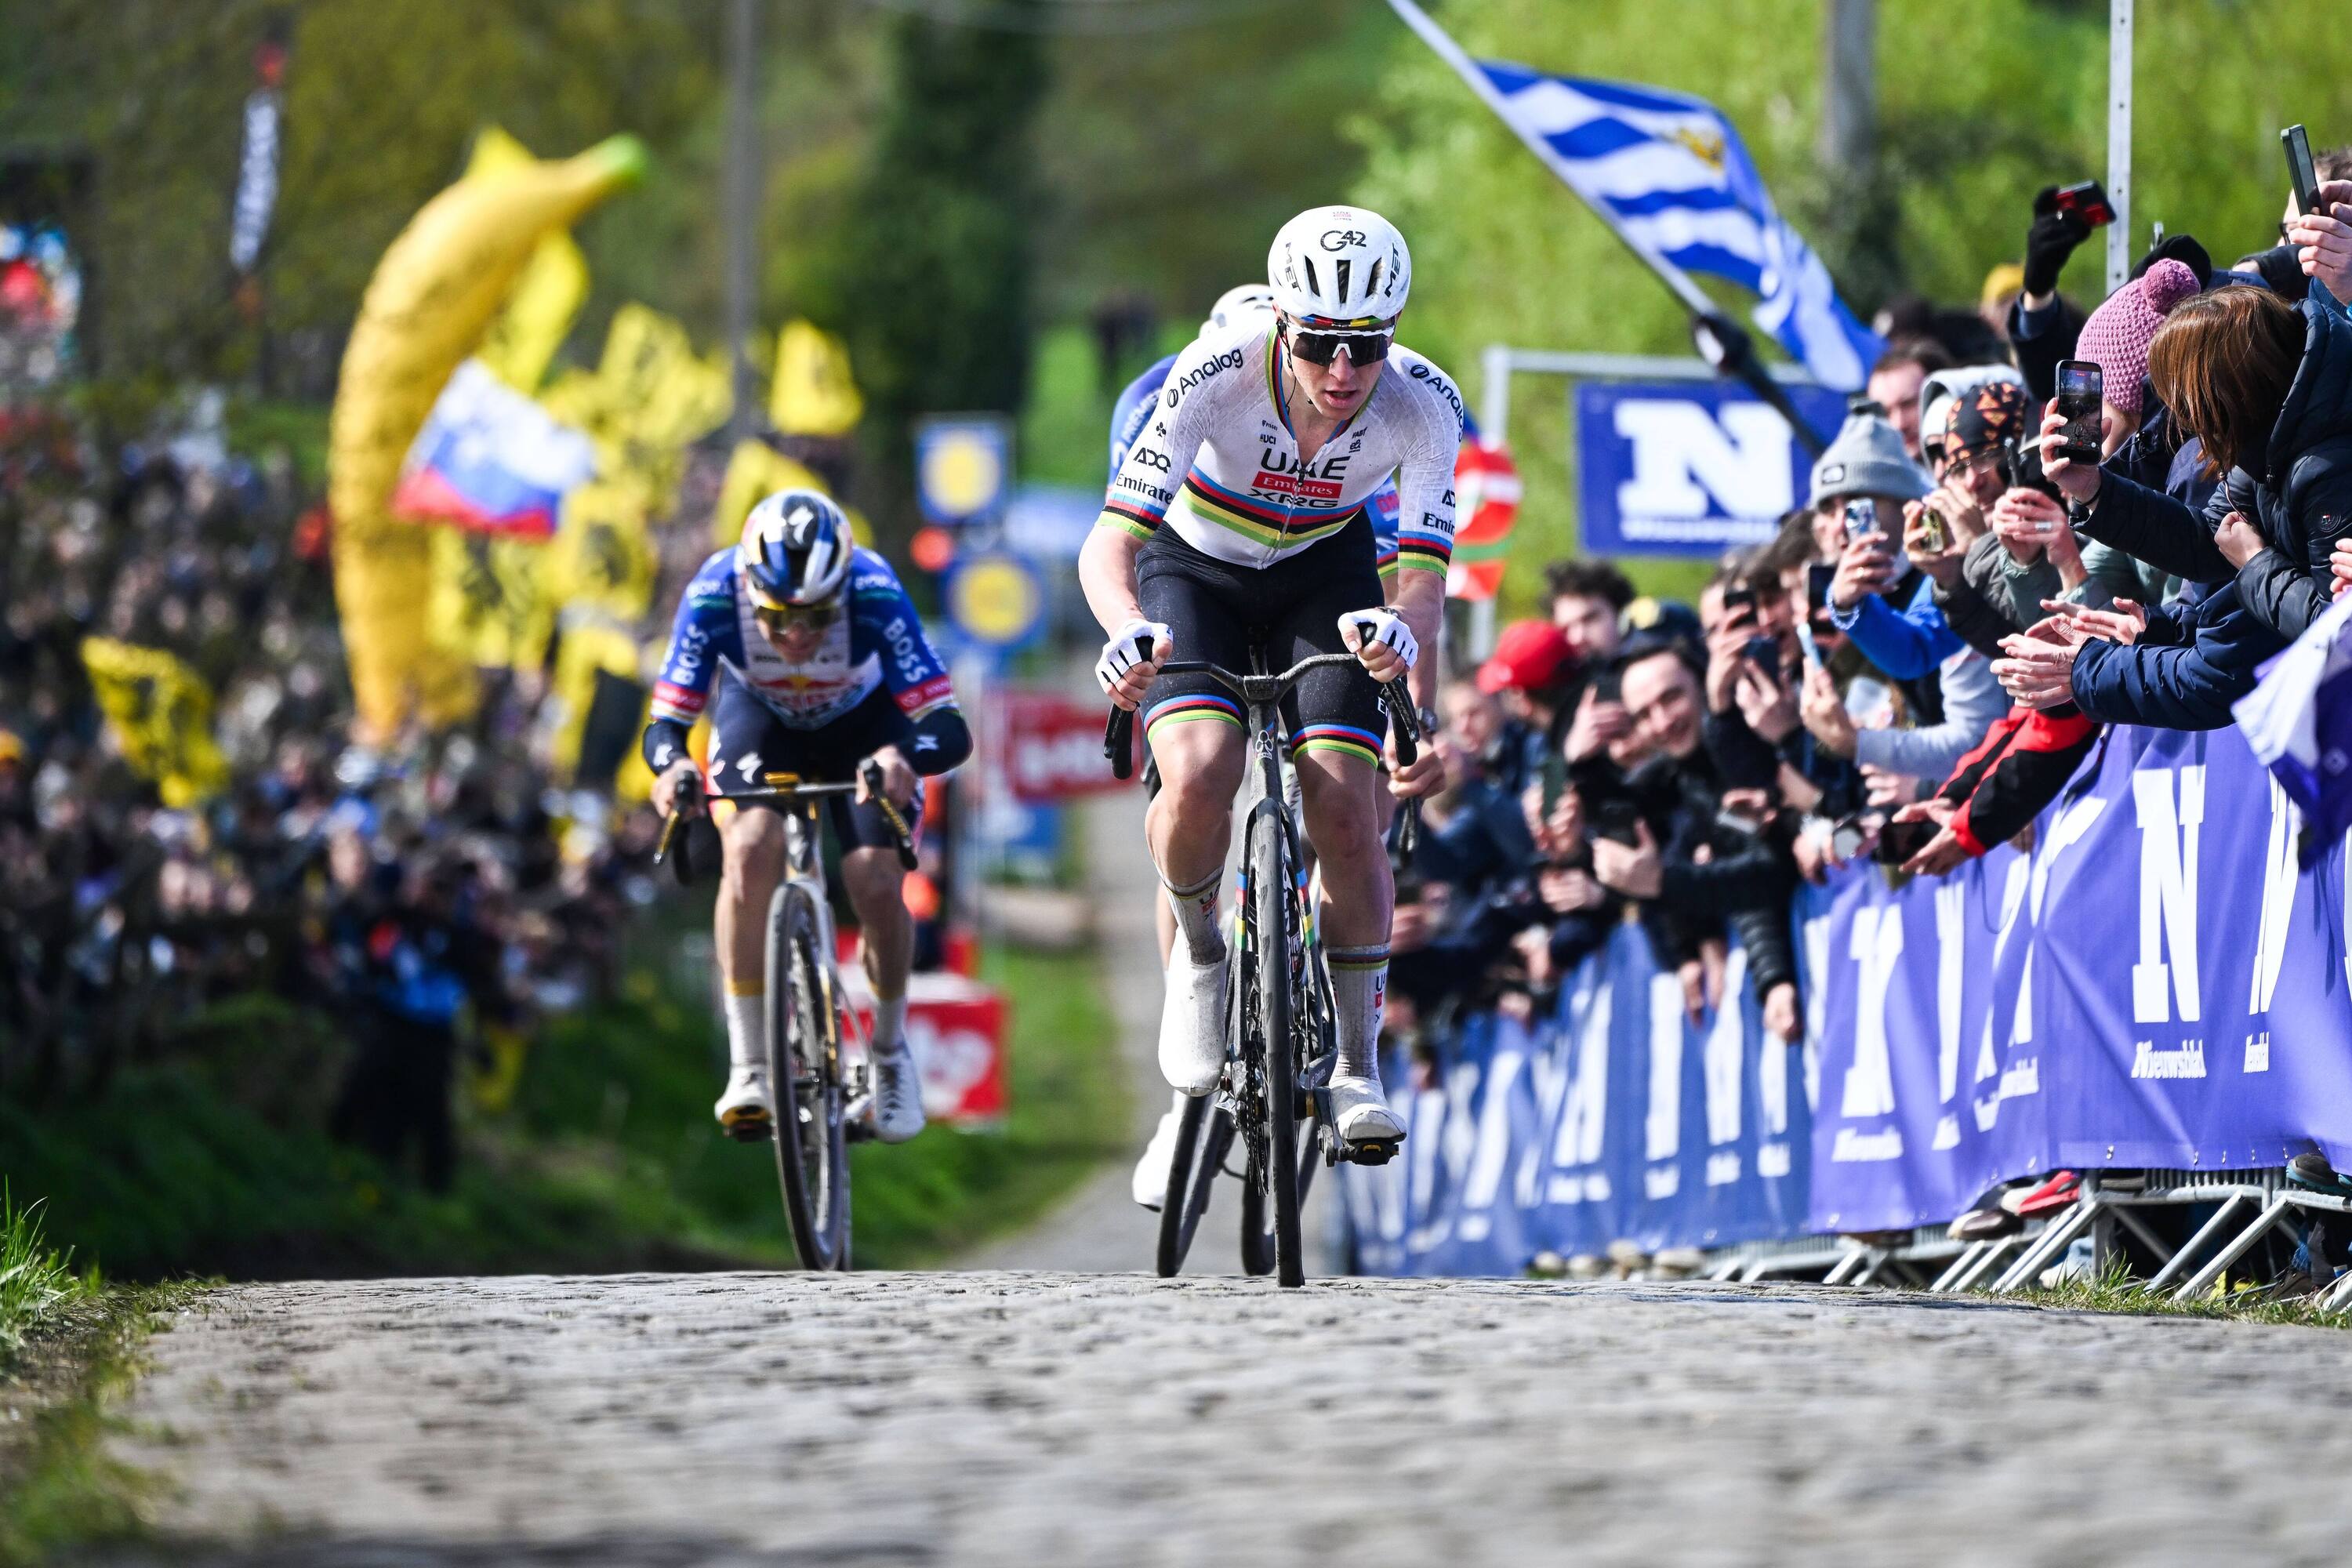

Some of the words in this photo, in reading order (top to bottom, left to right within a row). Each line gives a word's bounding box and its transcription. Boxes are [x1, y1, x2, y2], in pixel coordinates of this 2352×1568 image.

[1320, 230, 1367, 252] G42
[1285, 242, 1302, 292] MET
[1384, 242, 1401, 298] MET
[1180, 348, 1243, 395] Analog
[1263, 434, 1276, 445] UCI
[1614, 400, 1794, 520] N
[1261, 448, 1351, 481] UAE
[1116, 474, 1174, 506] Emirate
[1247, 488, 1338, 509] XRG
[670, 623, 710, 687] BOSS
[884, 617, 930, 683] BOSS
[2132, 765, 2206, 1022] N
[2131, 1039, 2207, 1080] Nieuwsblad
